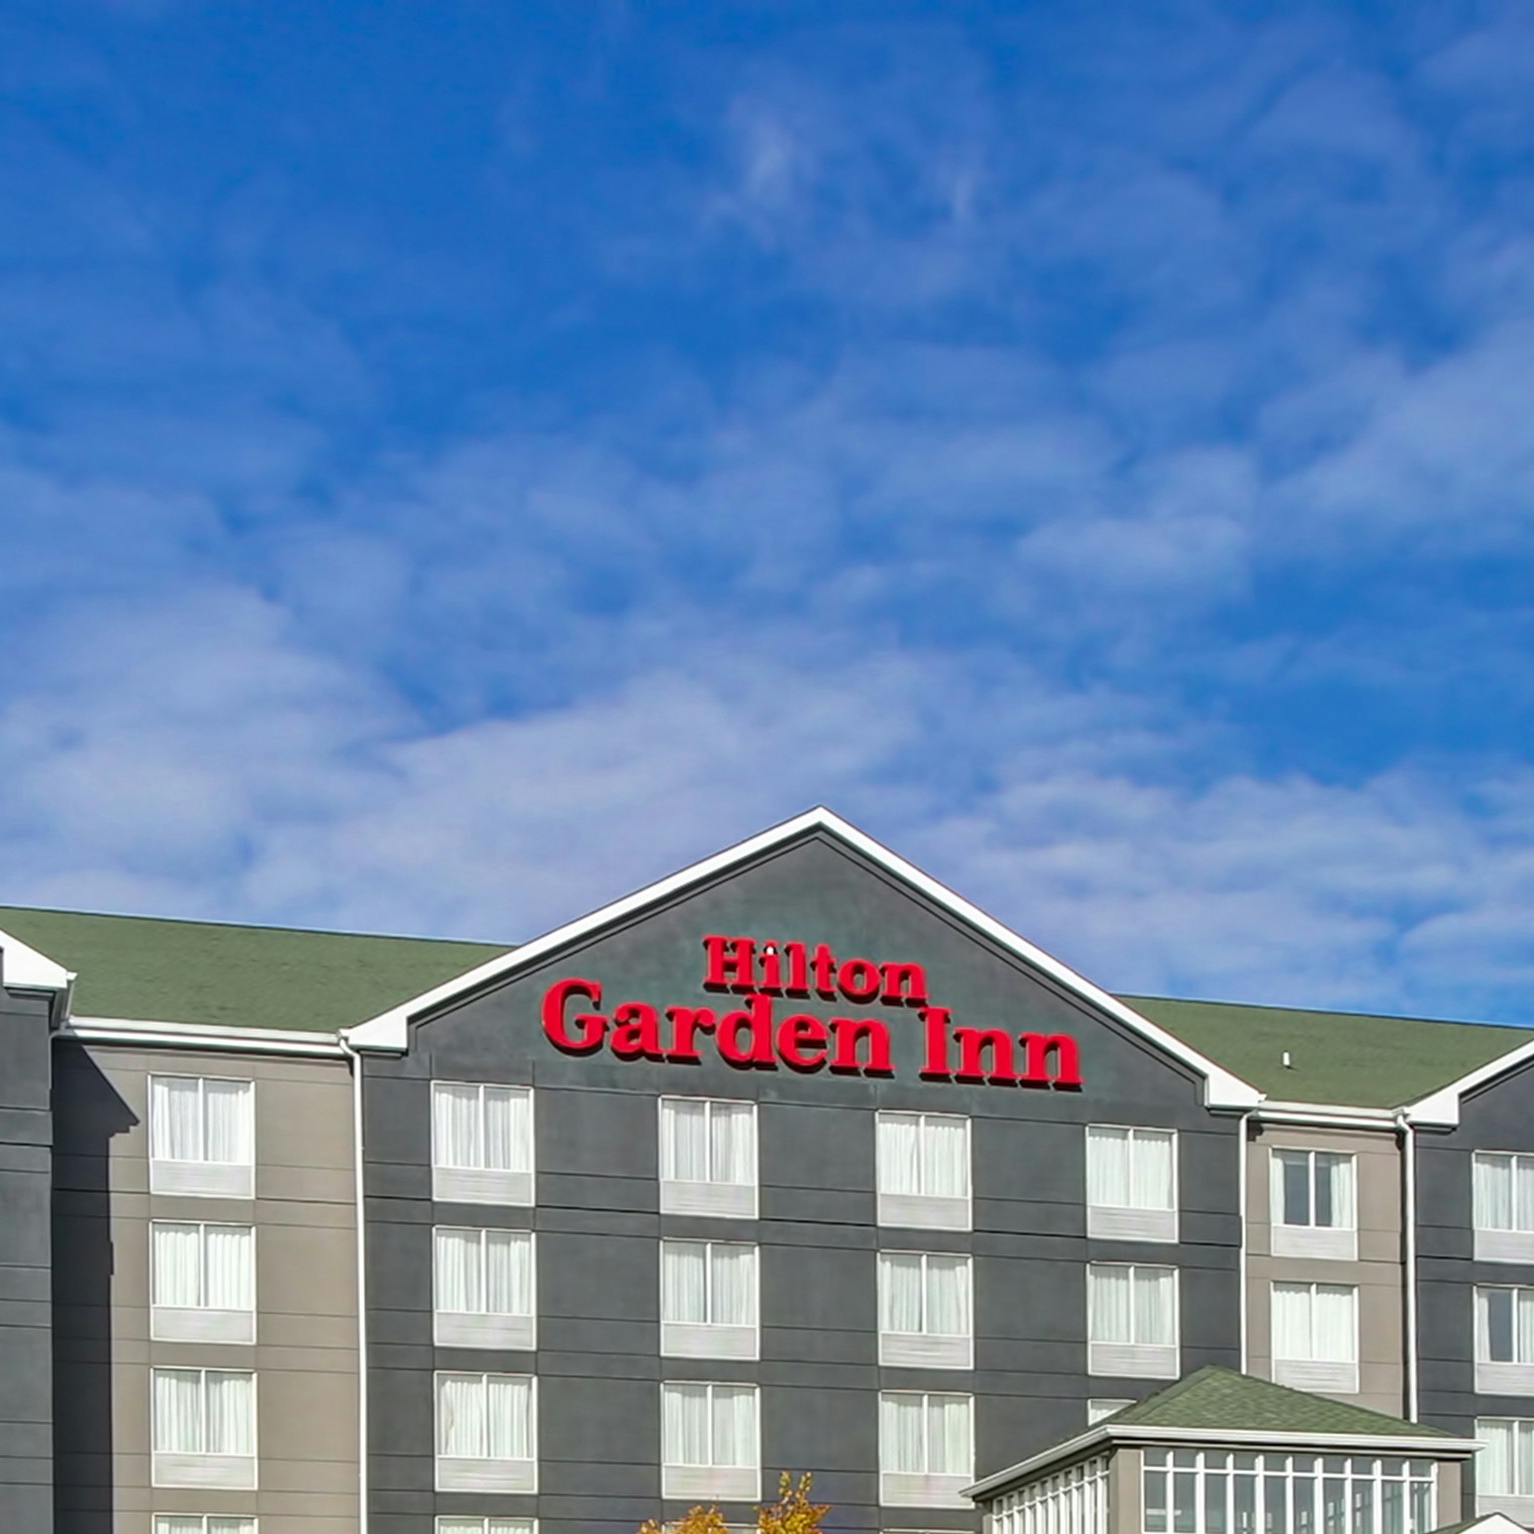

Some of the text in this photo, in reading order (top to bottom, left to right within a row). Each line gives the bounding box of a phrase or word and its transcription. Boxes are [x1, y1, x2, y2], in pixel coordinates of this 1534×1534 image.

[703, 934, 930, 1003] Hilton
[541, 977, 1086, 1089] Garden Inn
